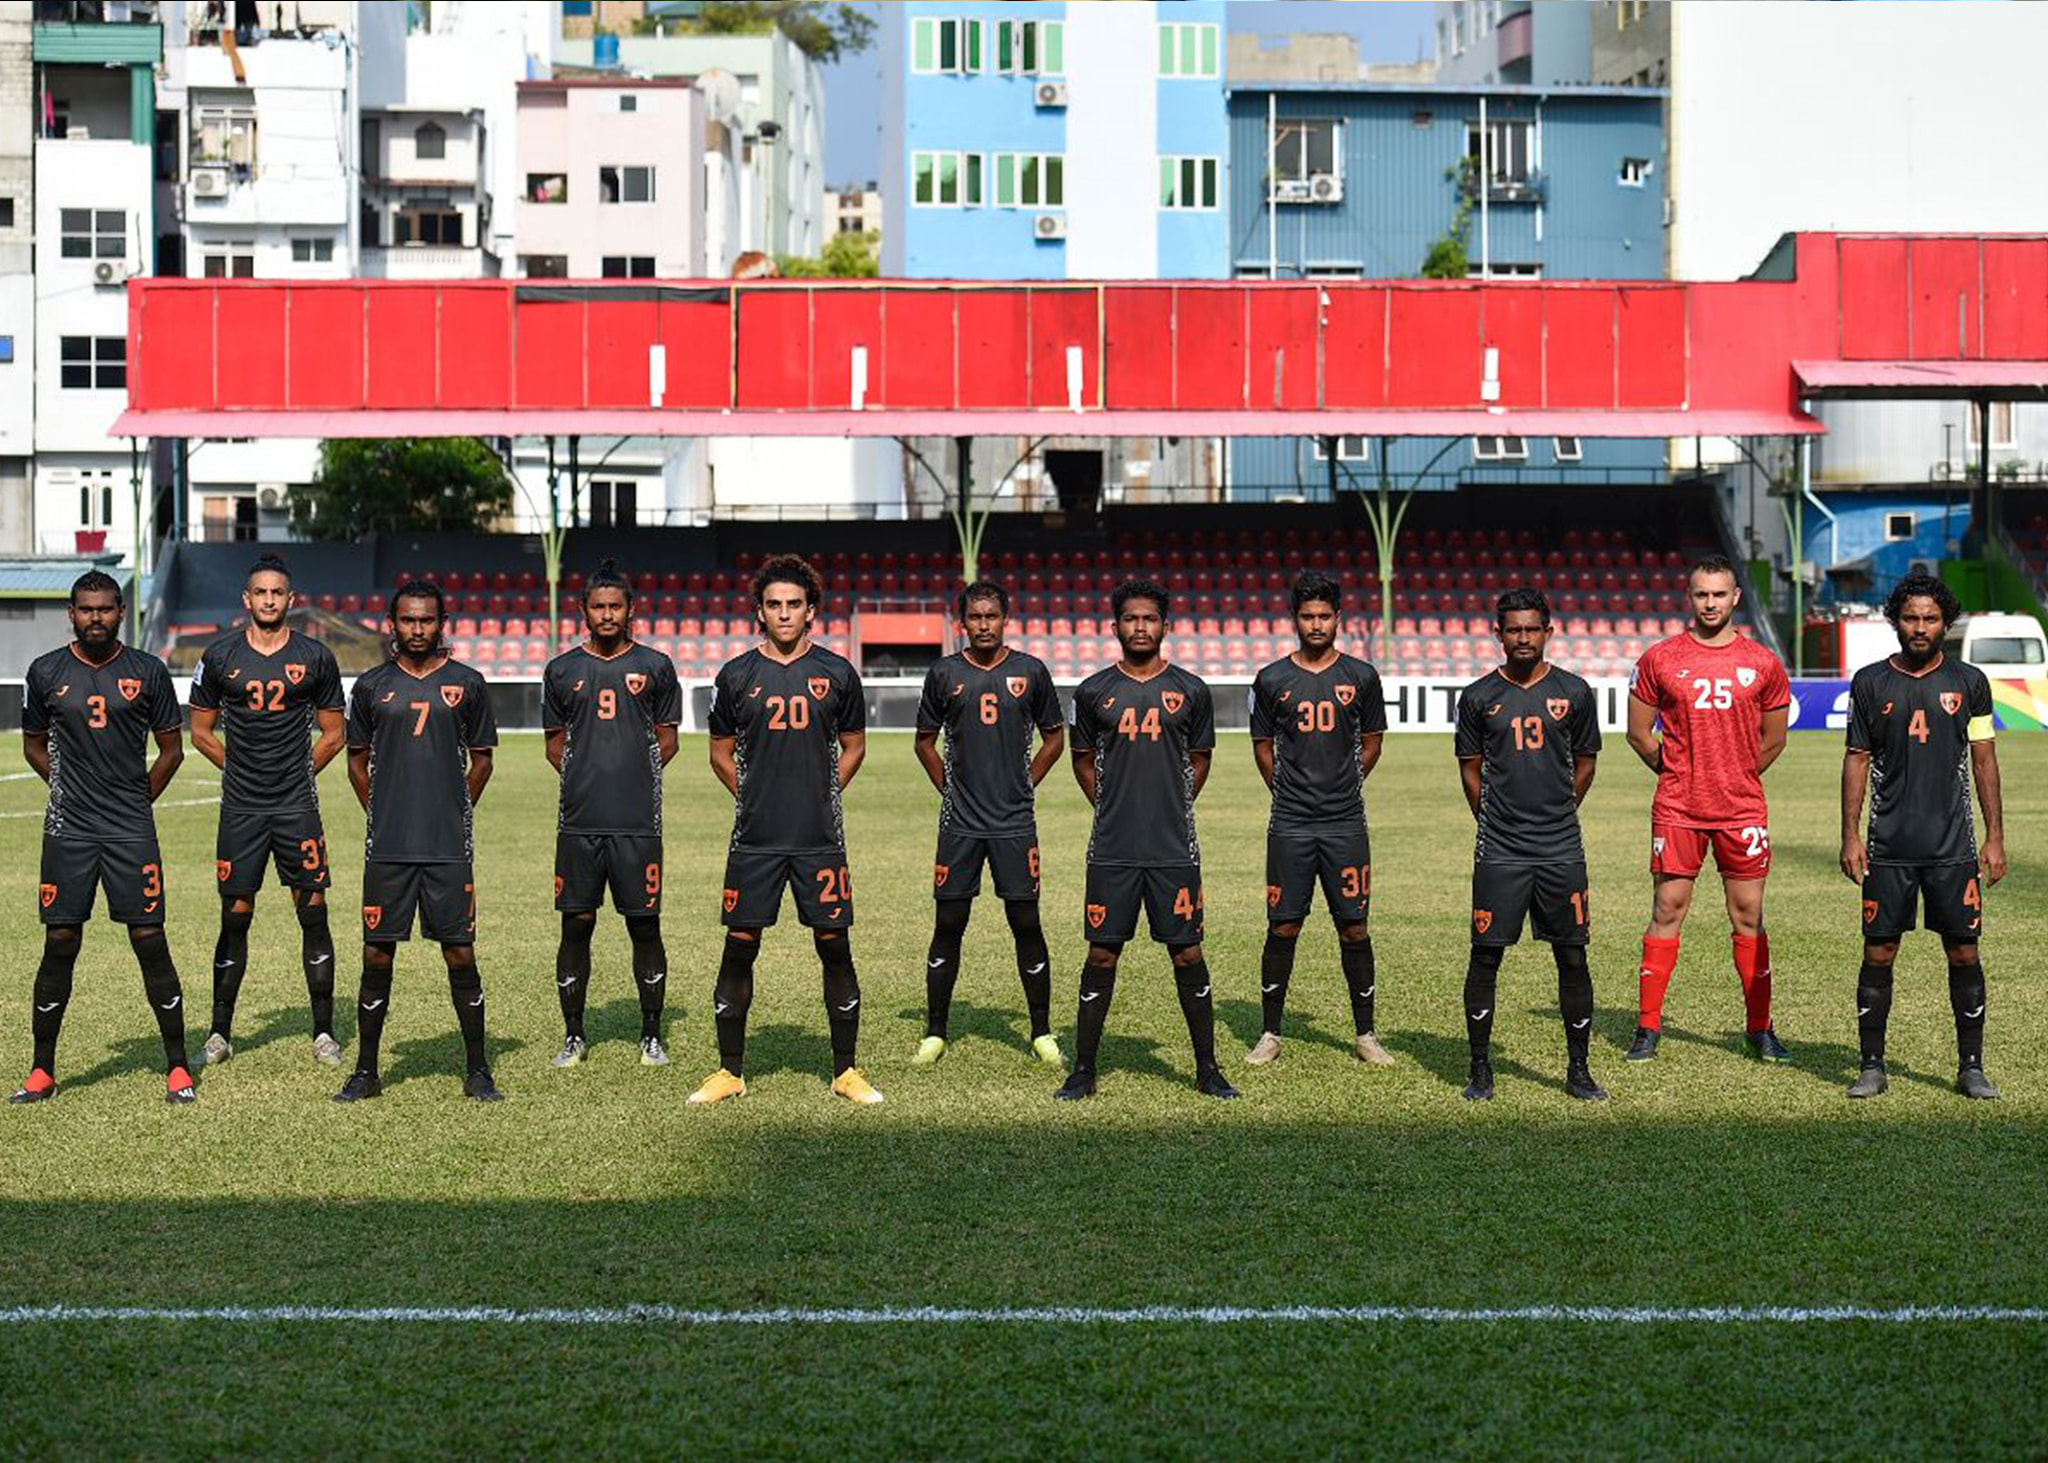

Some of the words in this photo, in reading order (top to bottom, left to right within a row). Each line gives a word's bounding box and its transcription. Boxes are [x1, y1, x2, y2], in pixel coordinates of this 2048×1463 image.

[245, 679, 285, 711] 32
[598, 690, 616, 720] 9
[980, 693, 998, 725] 6
[1692, 677, 1733, 710] 25
[86, 694, 107, 732] 3
[410, 701, 430, 737] 7
[765, 695, 809, 730] 20
[1118, 707, 1162, 742] 44
[1298, 700, 1335, 732] 30
[1908, 709, 1929, 744] 4
[1511, 717, 1544, 749] 13
[646, 863, 662, 894] 9
[1028, 847, 1040, 878] 6
[142, 863, 161, 898] 3
[816, 866, 851, 903] 20
[1341, 865, 1370, 898] 30
[1963, 878, 1982, 912] 4
